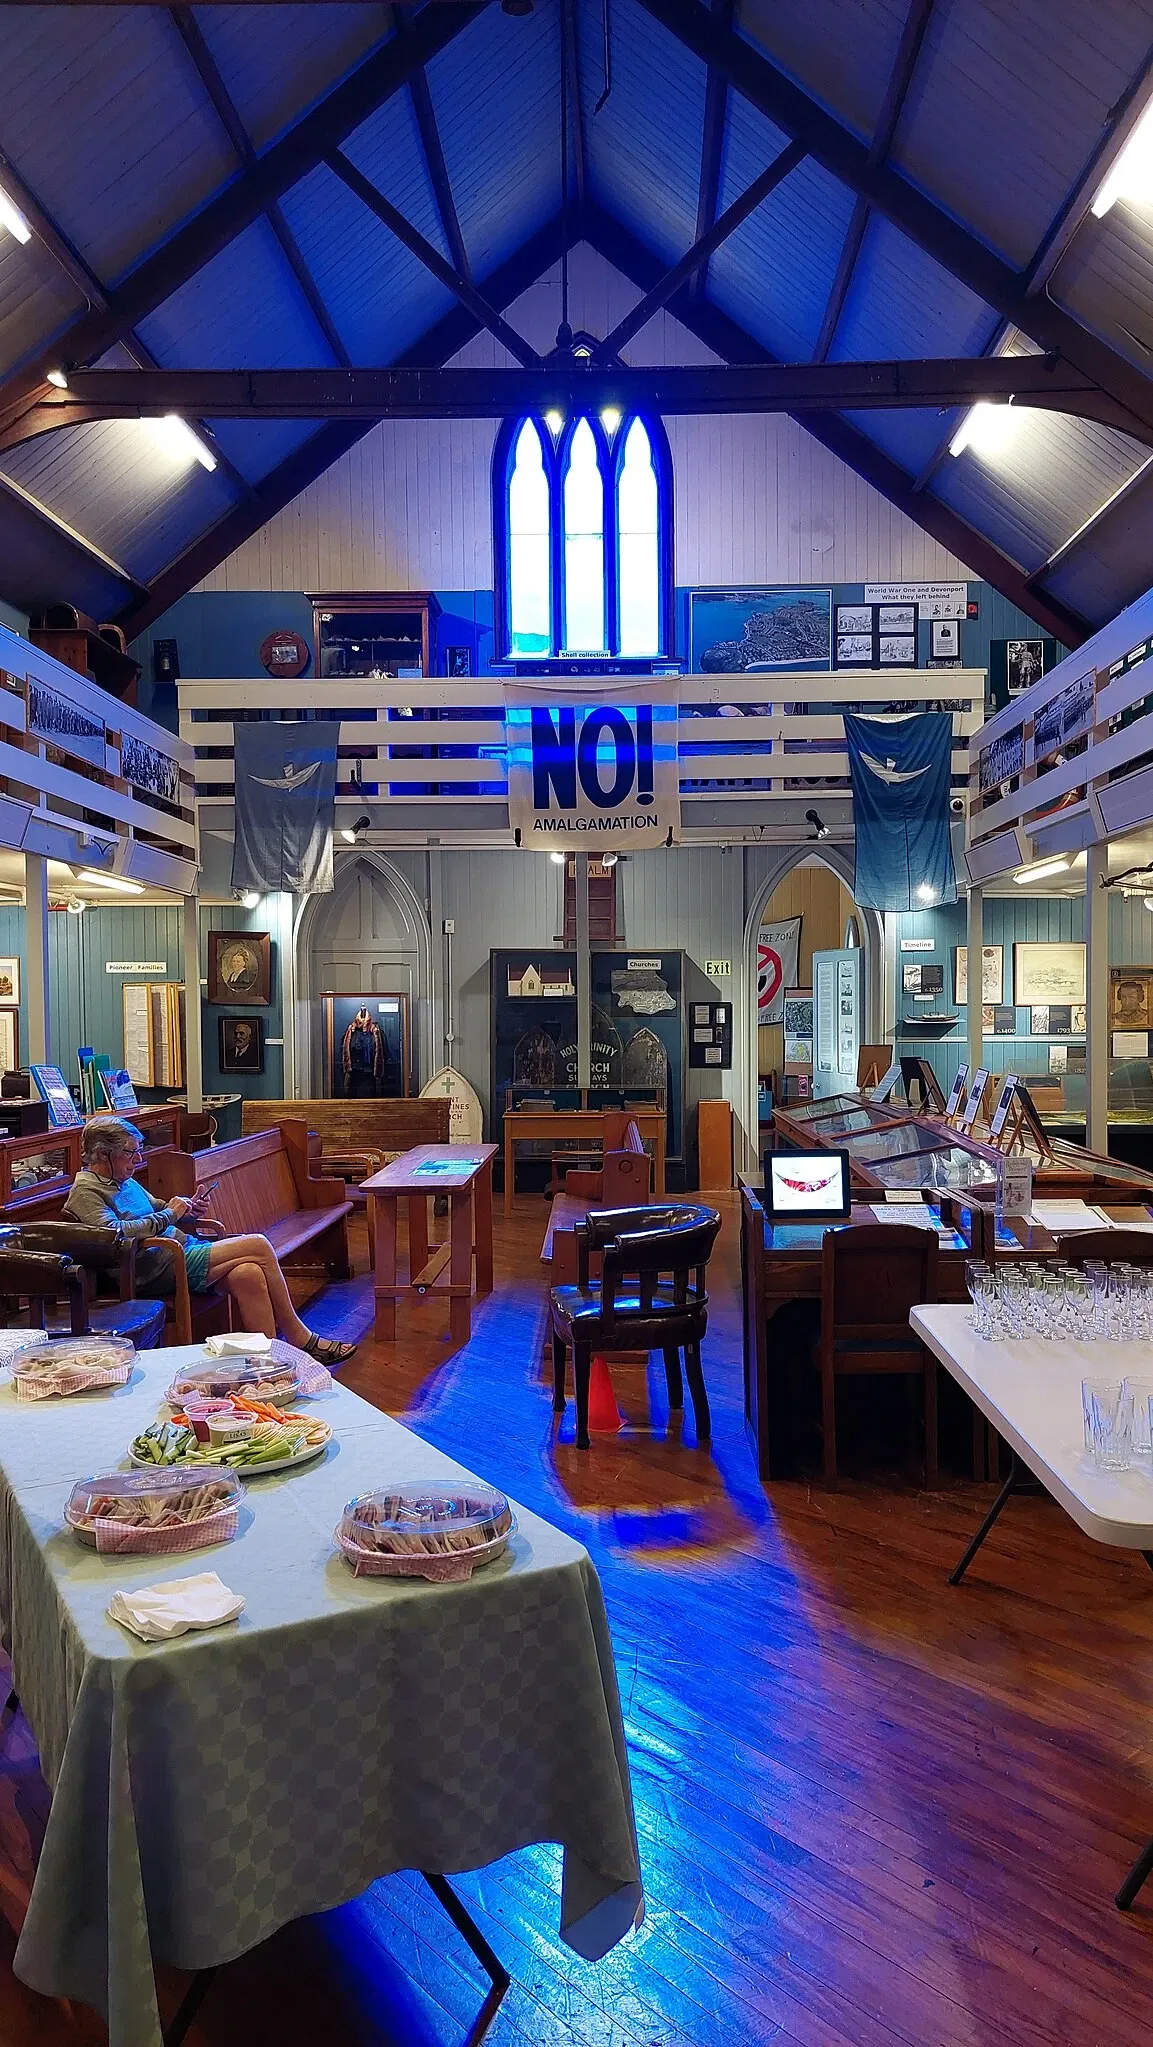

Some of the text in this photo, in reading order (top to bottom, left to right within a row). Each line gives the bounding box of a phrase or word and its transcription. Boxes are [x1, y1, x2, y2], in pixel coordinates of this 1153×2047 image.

[530, 704, 655, 809] NO!
[533, 815, 658, 831] AMALGAMATION
[760, 934, 774, 942] FREE
[706, 962, 730, 974] Exit
[560, 1044, 579, 1058] HOLY
[566, 1062, 610, 1072] CHRCH
